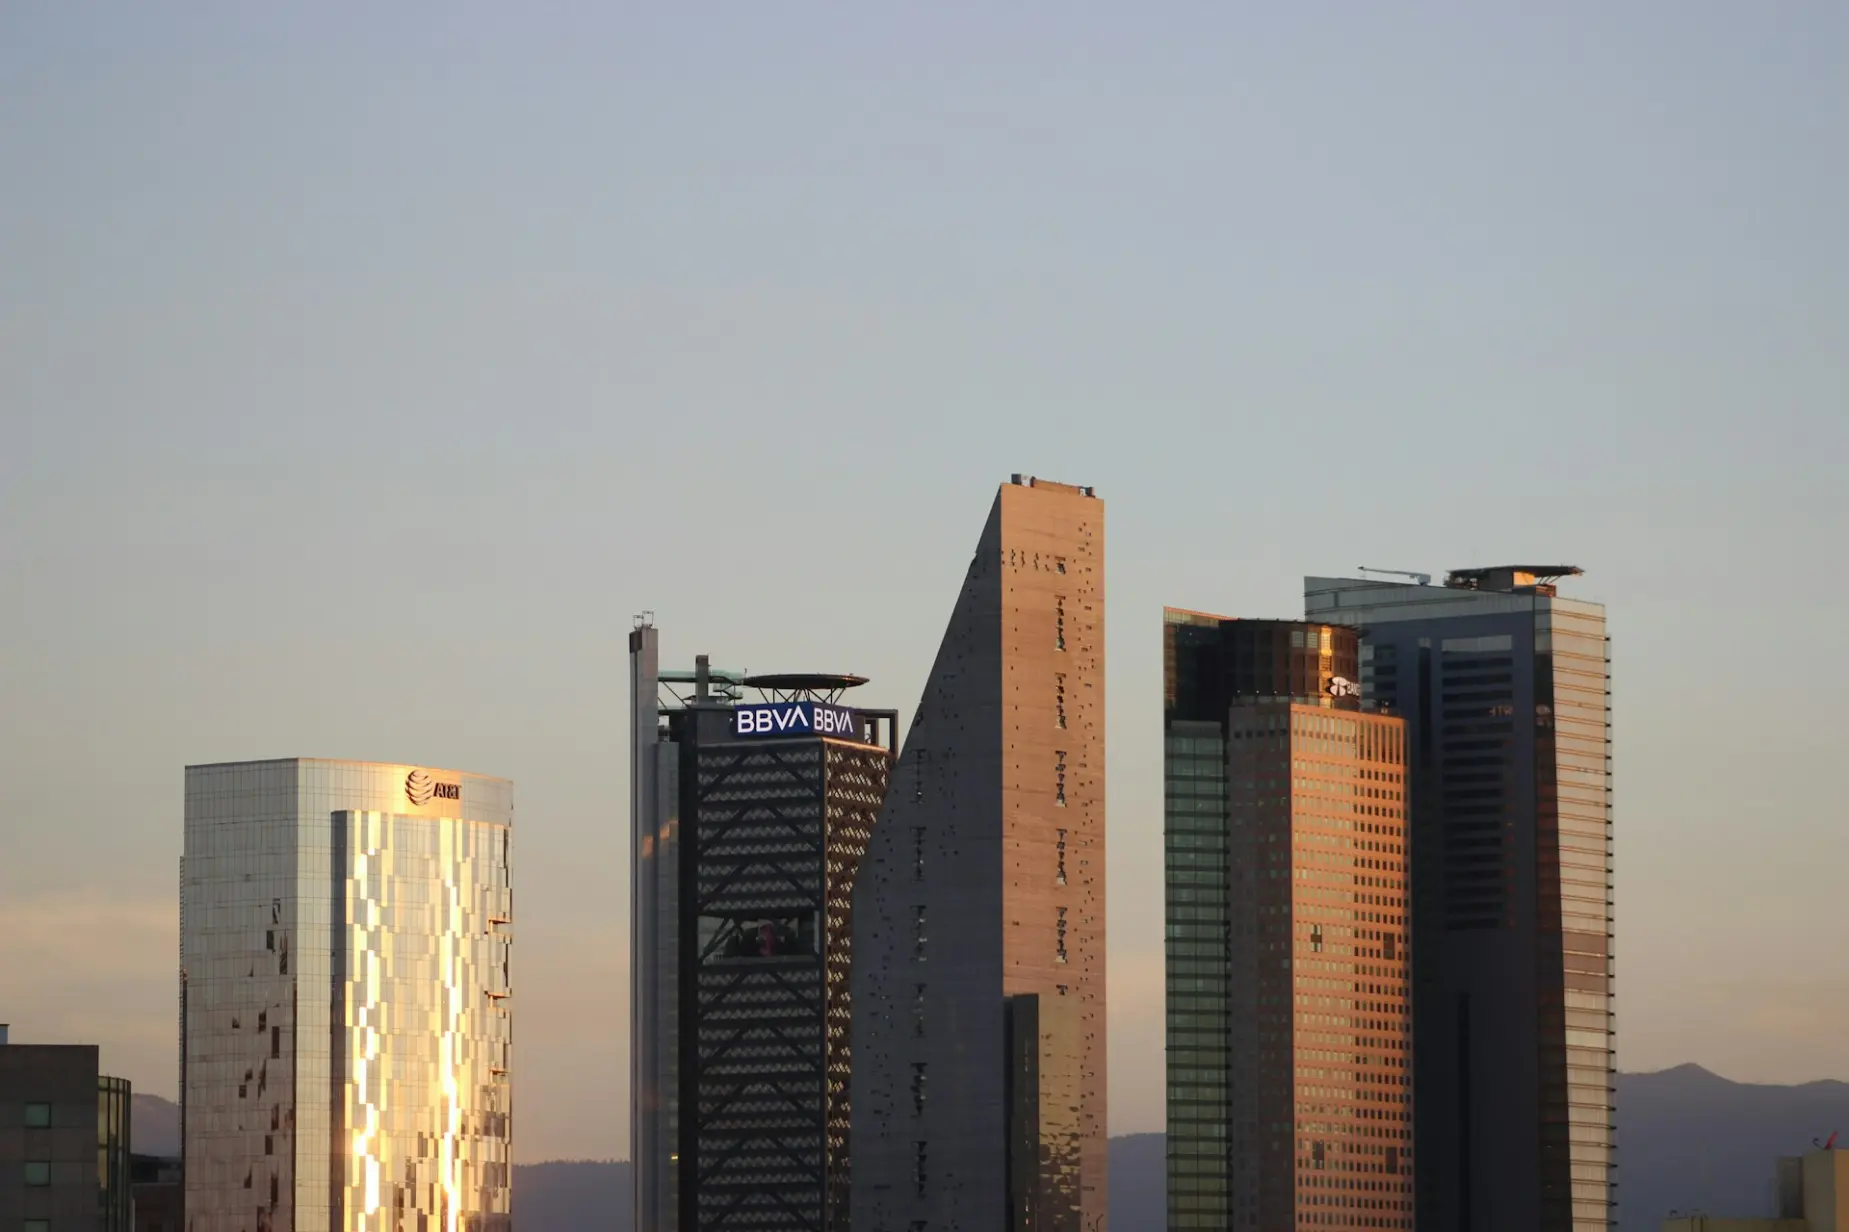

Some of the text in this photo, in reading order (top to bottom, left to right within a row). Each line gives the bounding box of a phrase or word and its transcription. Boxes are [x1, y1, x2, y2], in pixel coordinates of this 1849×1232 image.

[737, 704, 809, 733] BBVA
[813, 707, 854, 734] BBVA
[433, 782, 462, 800] AT&T
